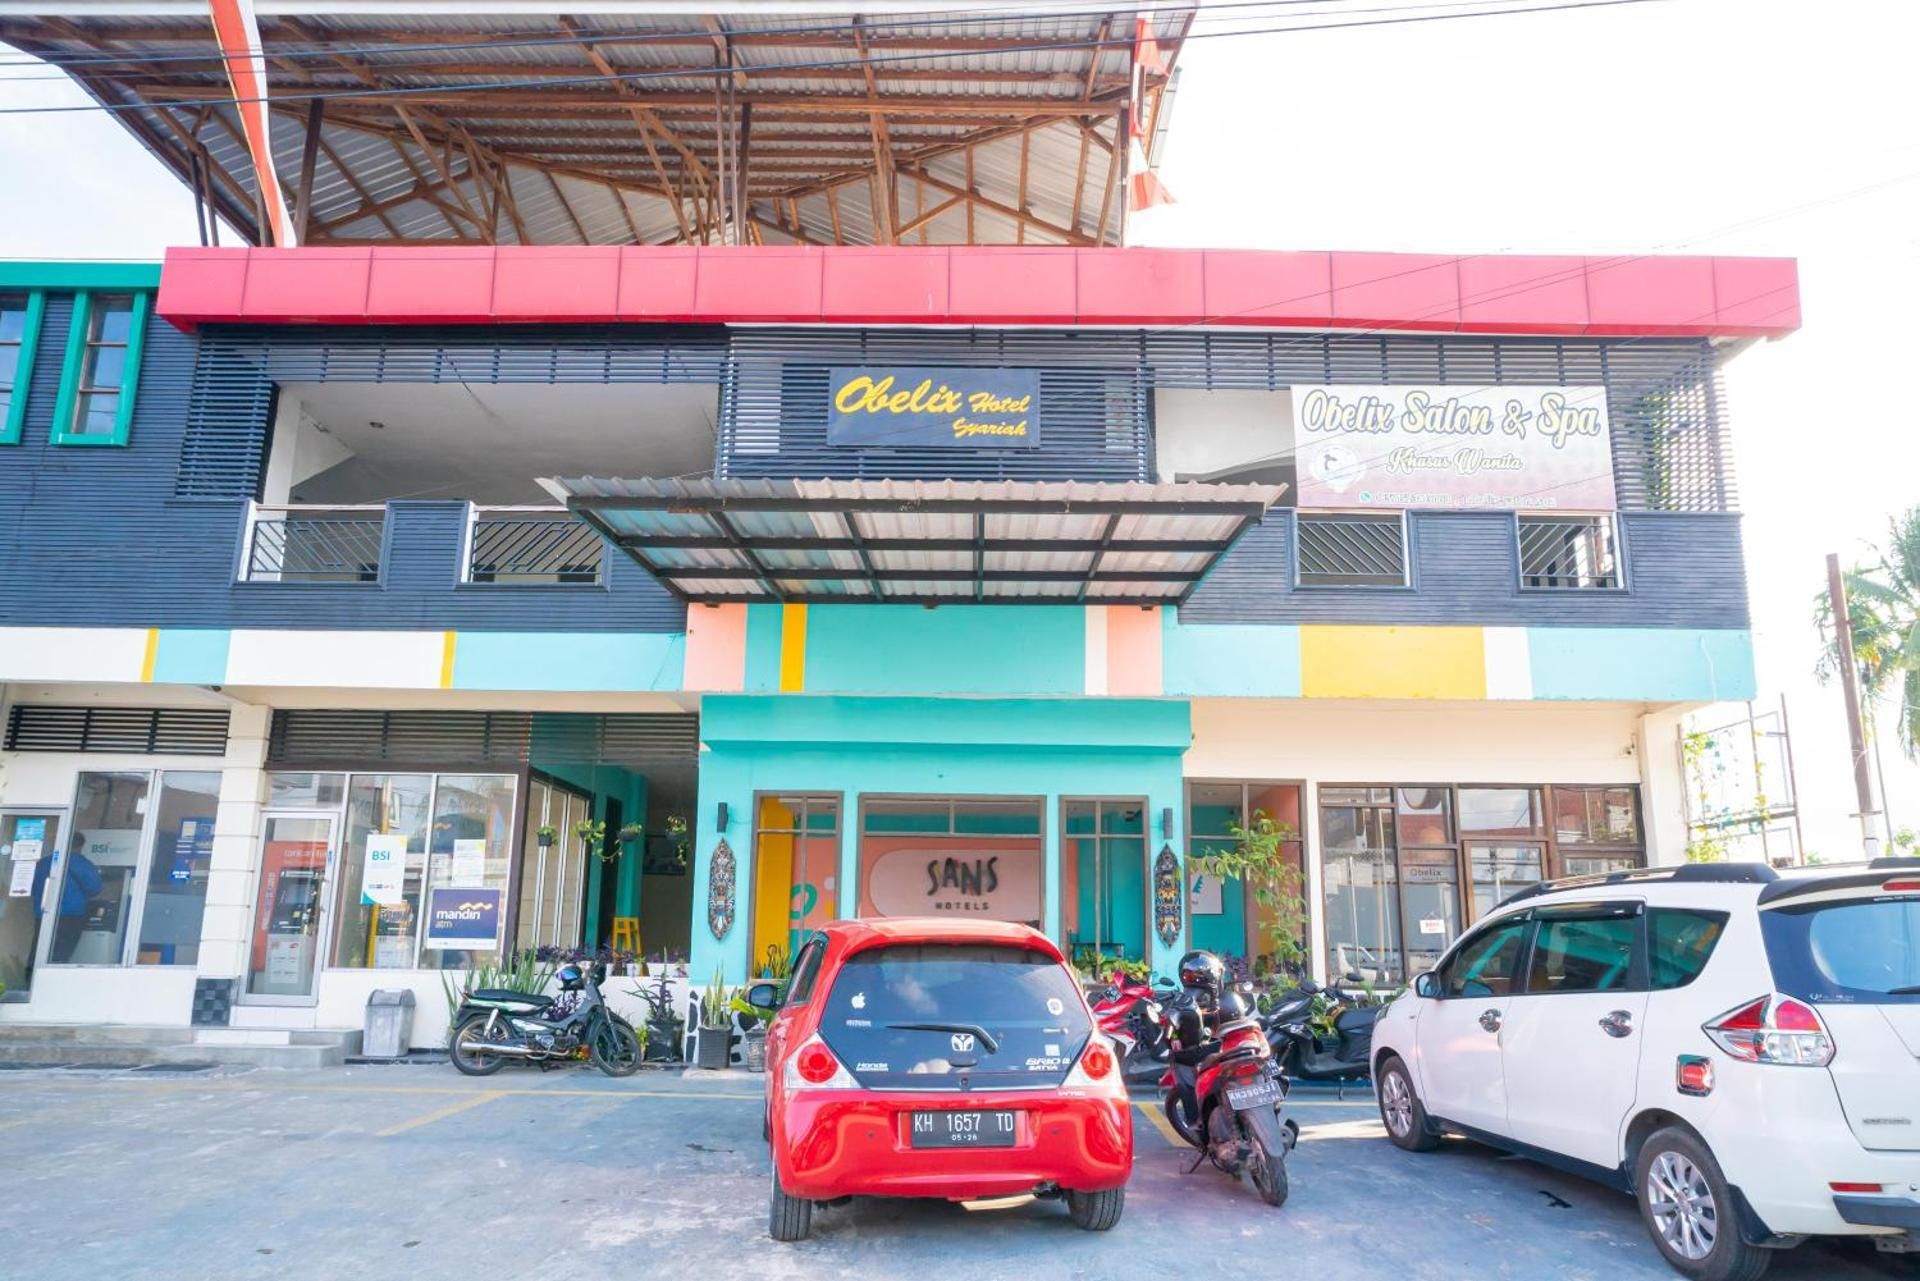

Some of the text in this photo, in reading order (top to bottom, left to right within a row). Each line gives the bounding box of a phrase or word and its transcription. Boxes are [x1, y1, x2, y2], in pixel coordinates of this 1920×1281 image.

[835, 376, 1031, 414] Obelix Hotel
[952, 416, 1028, 439] Syariah
[1302, 389, 1601, 450] Obelix Salon & Spa
[1385, 446, 1523, 475] Khusus Wanita
[91, 844, 108, 854] BSI
[371, 850, 390, 861] BSI
[927, 856, 998, 896] SANS
[935, 902, 989, 911] HOTELS
[914, 1112, 1014, 1132] KH 1657 TD
